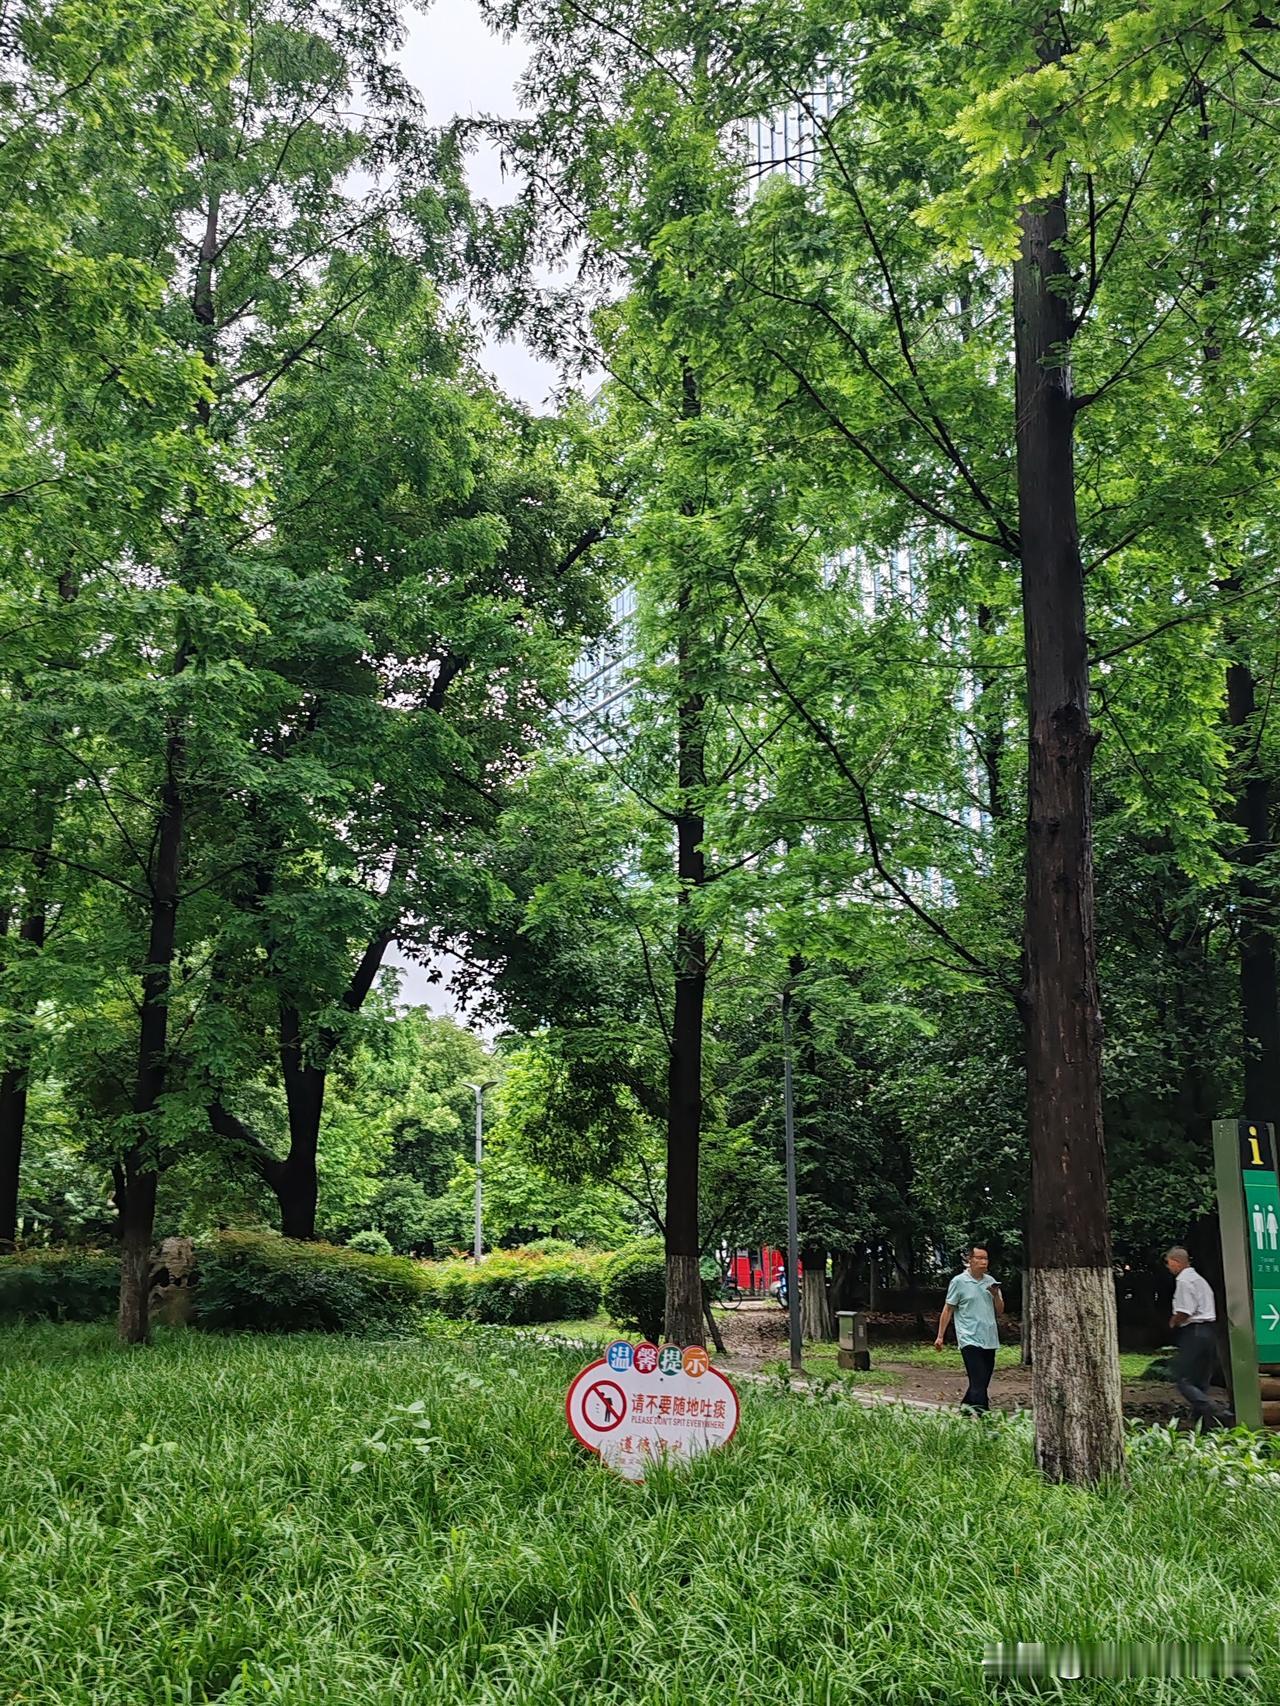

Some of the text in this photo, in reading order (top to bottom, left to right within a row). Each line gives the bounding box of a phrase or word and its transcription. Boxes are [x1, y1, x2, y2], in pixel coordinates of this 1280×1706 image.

[611, 1346, 707, 1375] 温馨提示
[631, 1393, 726, 1419] 请不要随地吐痰
[631, 1415, 726, 1430] PLEASE DON'T SPIT EVERYWHERE
